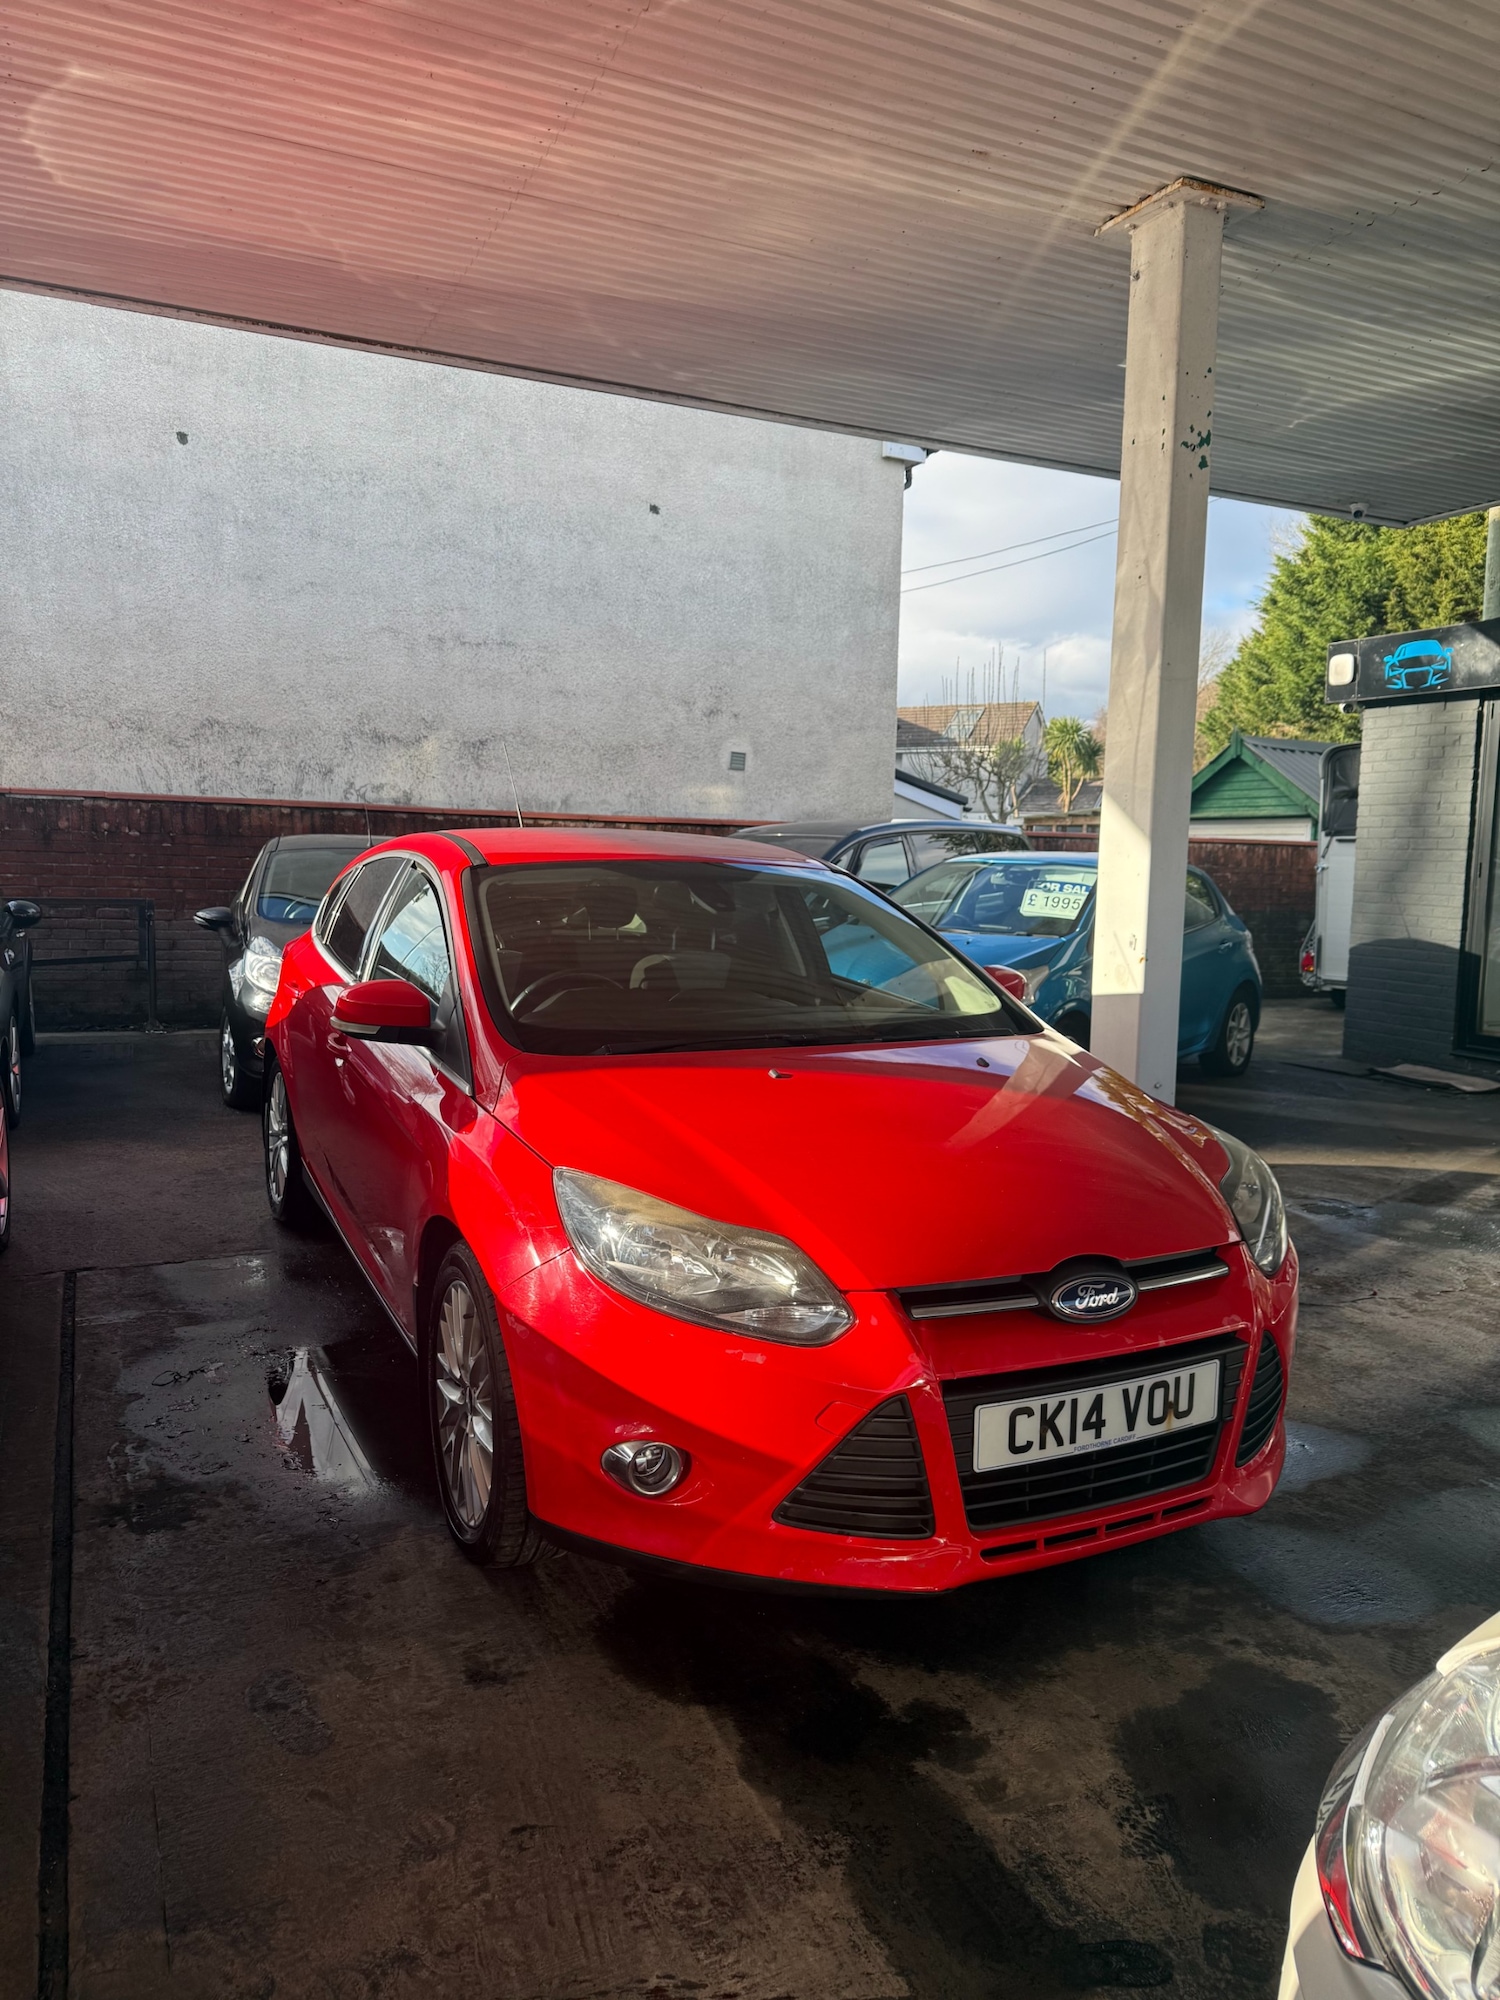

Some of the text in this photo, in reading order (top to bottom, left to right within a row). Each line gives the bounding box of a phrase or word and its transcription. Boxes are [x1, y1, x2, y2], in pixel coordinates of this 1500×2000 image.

[1032, 882, 1092, 895] FOR SAL
[1044, 895, 1082, 911] 1995
[1075, 1283, 1119, 1310] Ford
[1008, 1372, 1196, 1455] CK14 VOU
[1073, 1434, 1137, 1453] FORDTHORNE CARDIFF
